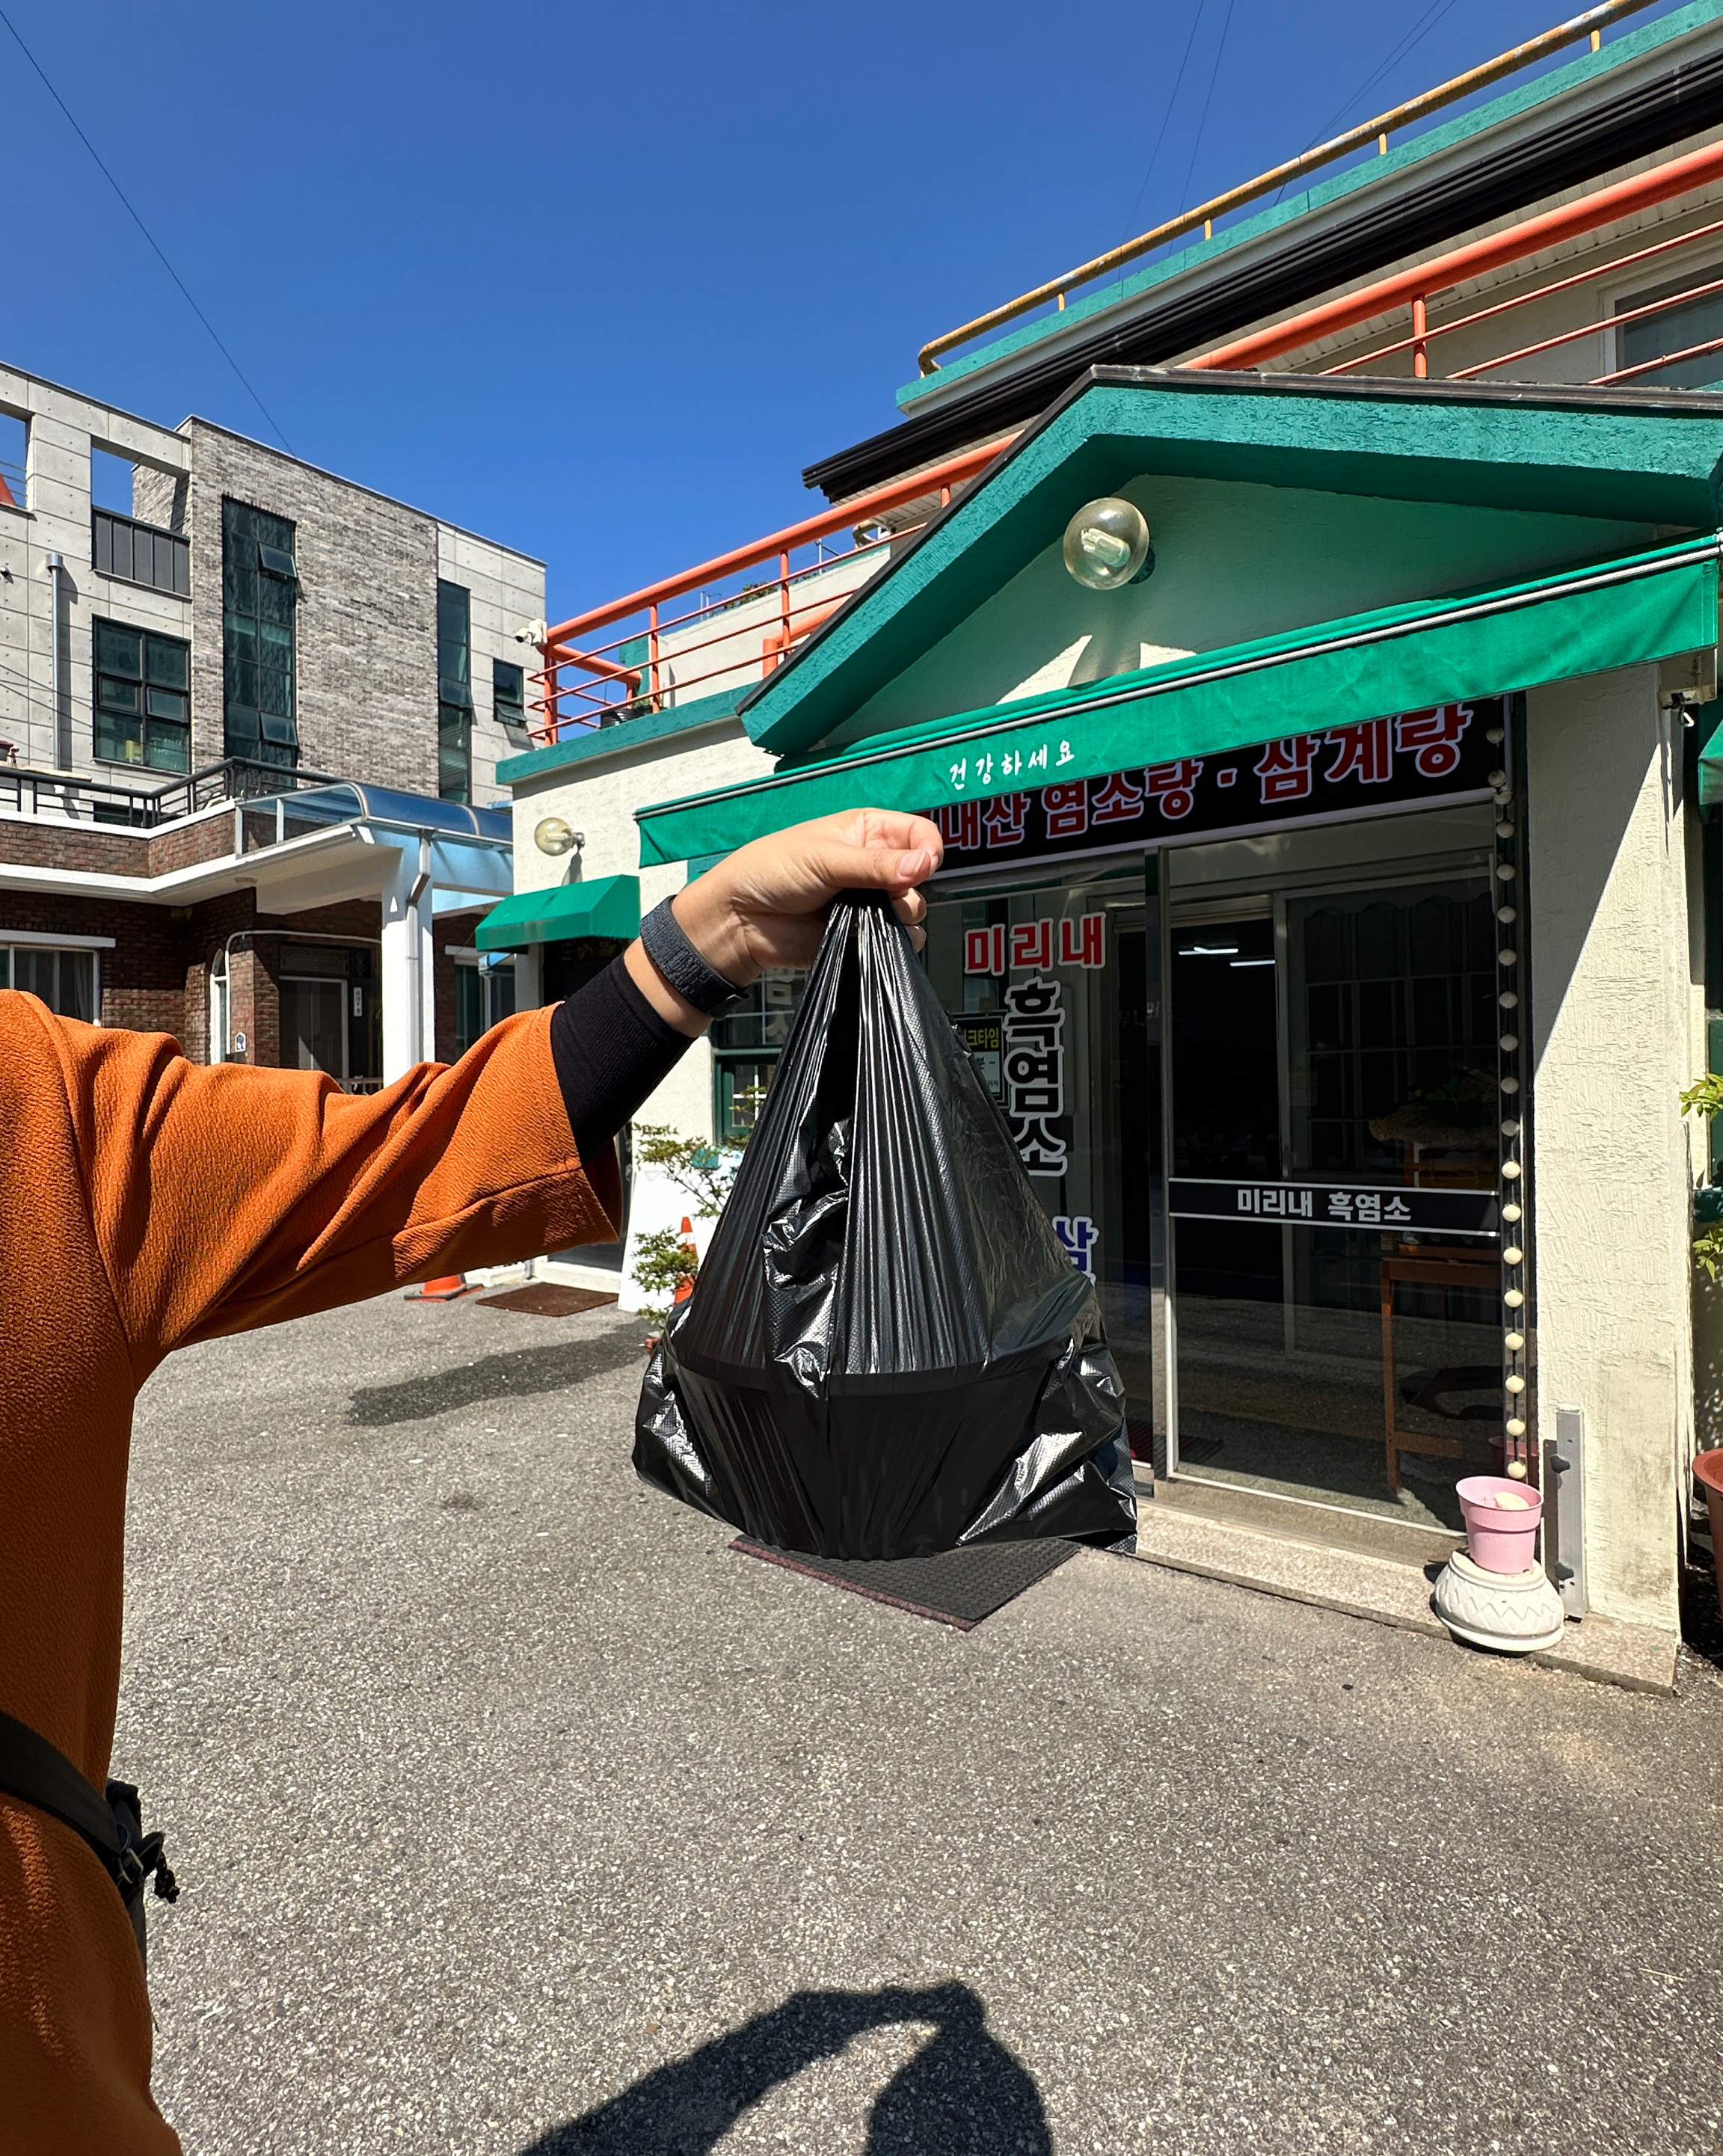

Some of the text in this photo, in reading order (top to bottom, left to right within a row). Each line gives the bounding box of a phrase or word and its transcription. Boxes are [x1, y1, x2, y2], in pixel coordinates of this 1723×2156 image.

[950, 740, 1075, 790] 건강하세요
[917, 793, 1031, 850] 내산
[965, 912, 1106, 975] 미리내
[963, 1027, 1000, 1049] 크타임
[1002, 976, 1068, 1176] 흑염소
[1238, 1189, 1412, 1222] 미리내 흑염소
[1052, 1216, 1099, 1286] 삼
